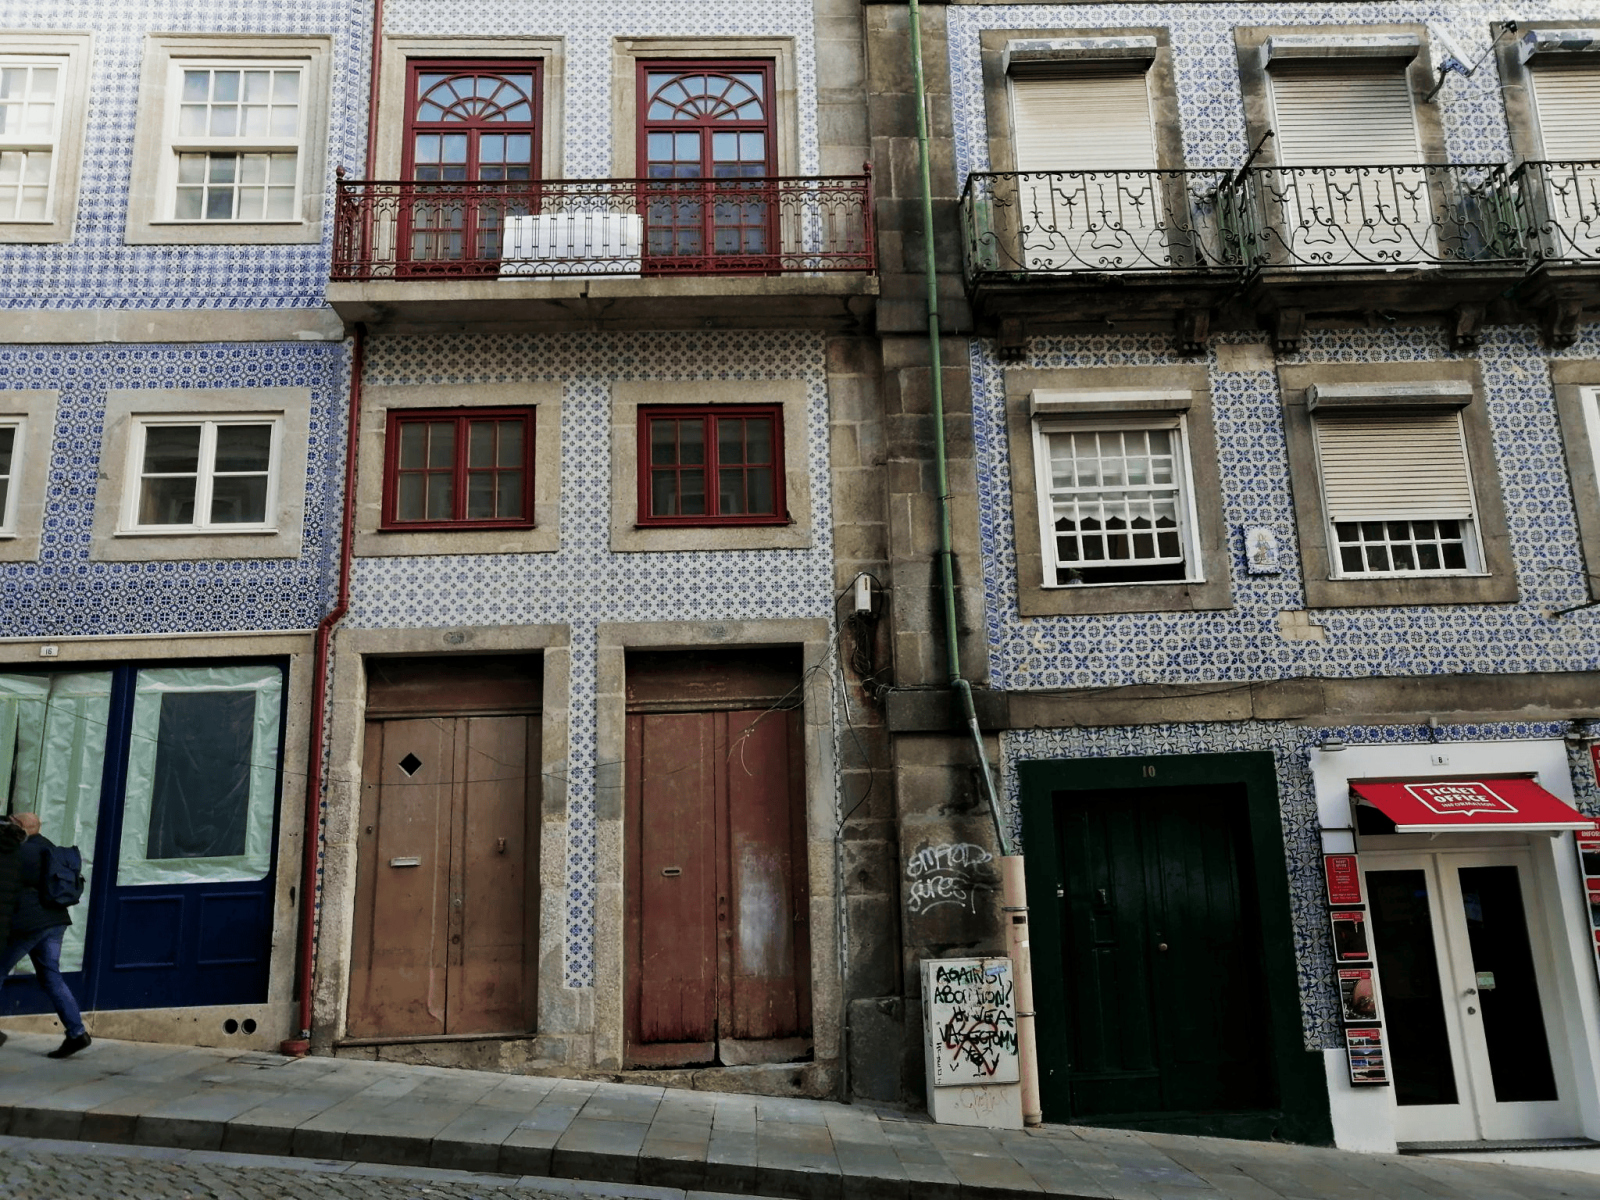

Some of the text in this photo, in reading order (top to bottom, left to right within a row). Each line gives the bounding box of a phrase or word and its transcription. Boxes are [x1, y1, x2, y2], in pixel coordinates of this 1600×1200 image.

[45, 647, 53, 655] 16
[1142, 765, 1156, 778] 10
[1422, 786, 1477, 796] TICKET
[1433, 794, 1489, 803] OFFICE
